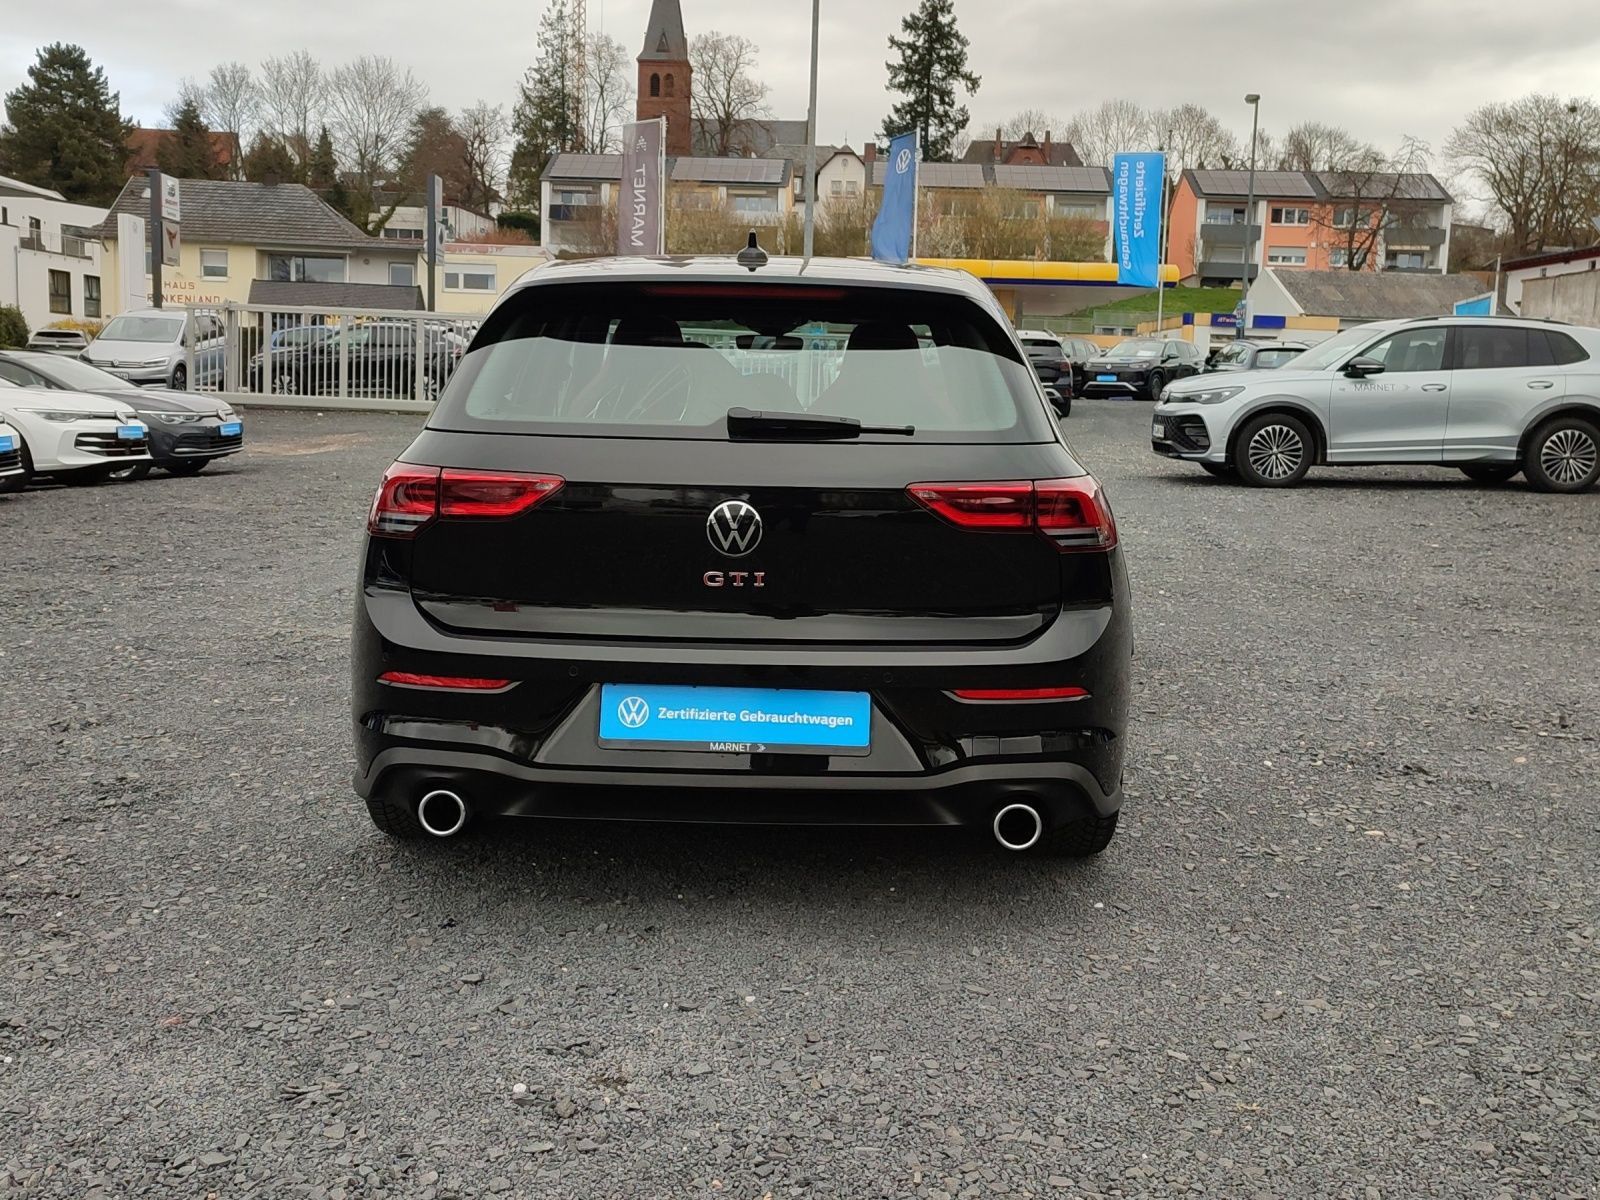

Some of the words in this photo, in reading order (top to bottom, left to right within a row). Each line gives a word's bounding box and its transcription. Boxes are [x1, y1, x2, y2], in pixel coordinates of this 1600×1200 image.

[164, 281, 195, 290] HAUS
[1354, 383, 1395, 392] MARNET
[703, 571, 765, 587] GTI
[658, 707, 736, 721] Zertifizierte
[740, 710, 853, 728] Gebrauchtwagen
[709, 742, 752, 752] MARNET
